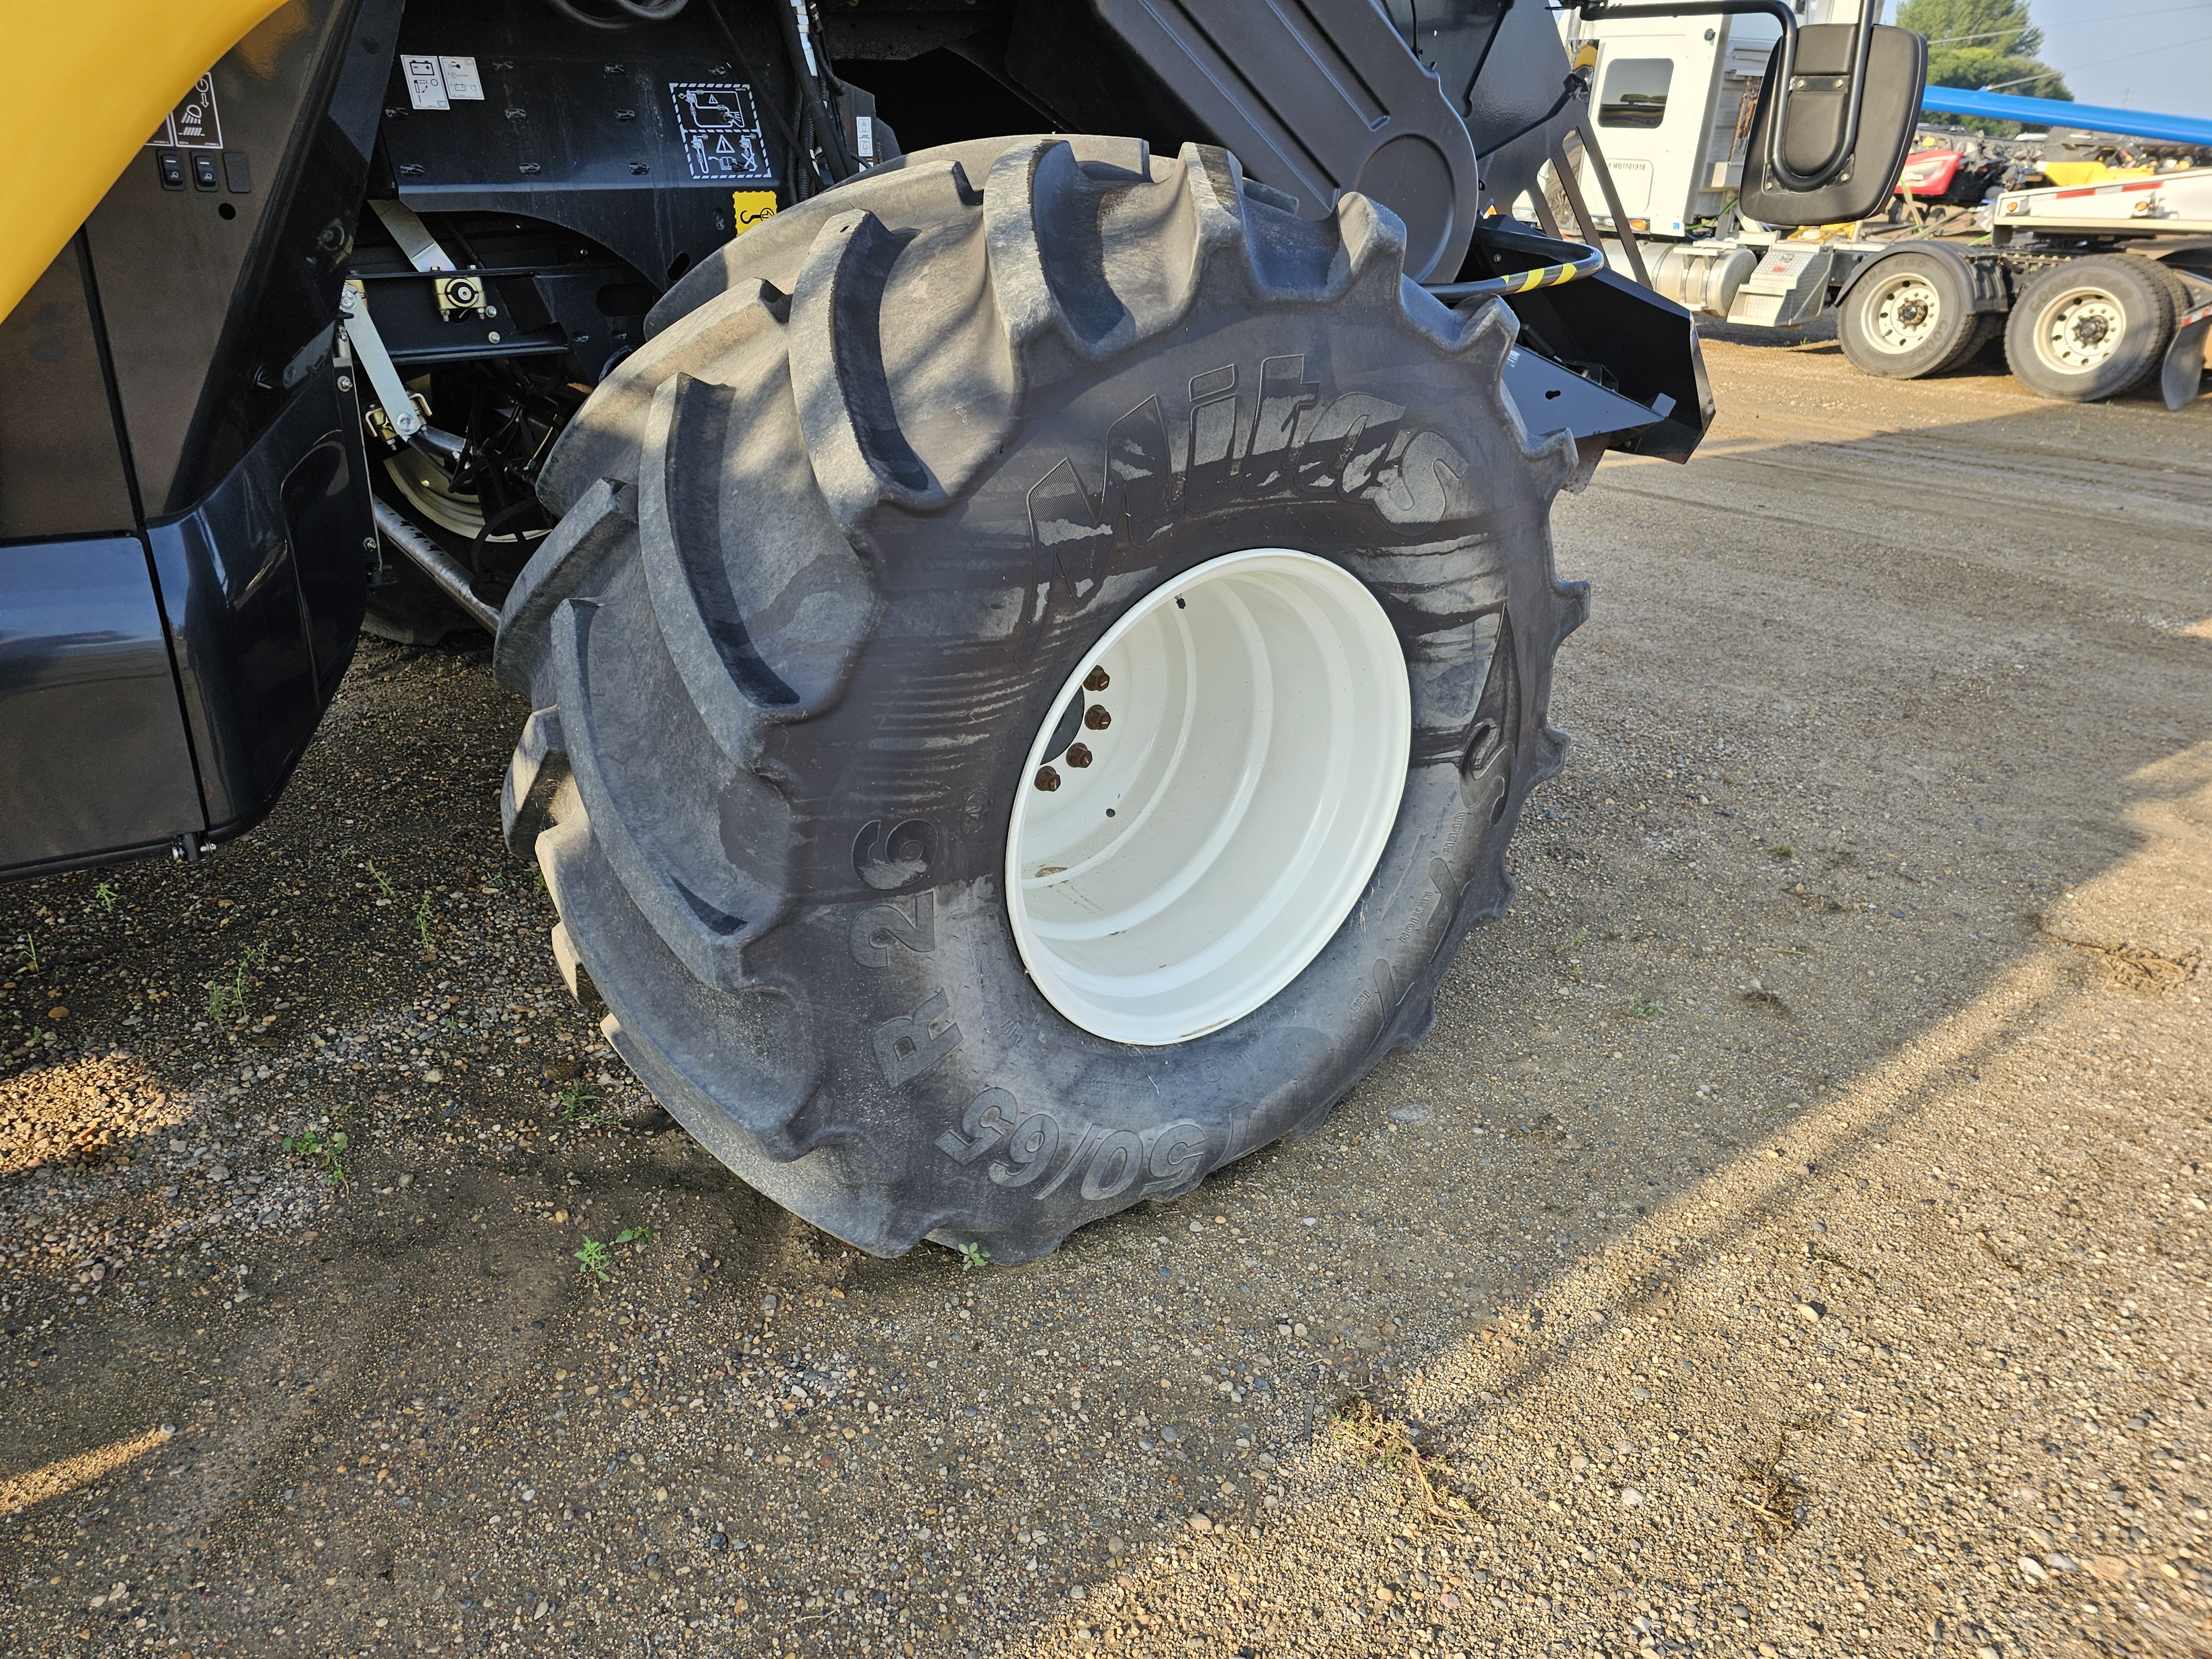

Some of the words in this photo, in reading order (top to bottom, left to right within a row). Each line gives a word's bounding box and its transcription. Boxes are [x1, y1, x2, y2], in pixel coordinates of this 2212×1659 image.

[1014, 354, 1471, 669] Mitas
[850, 818, 940, 969] 26
[872, 987, 964, 1089] R
